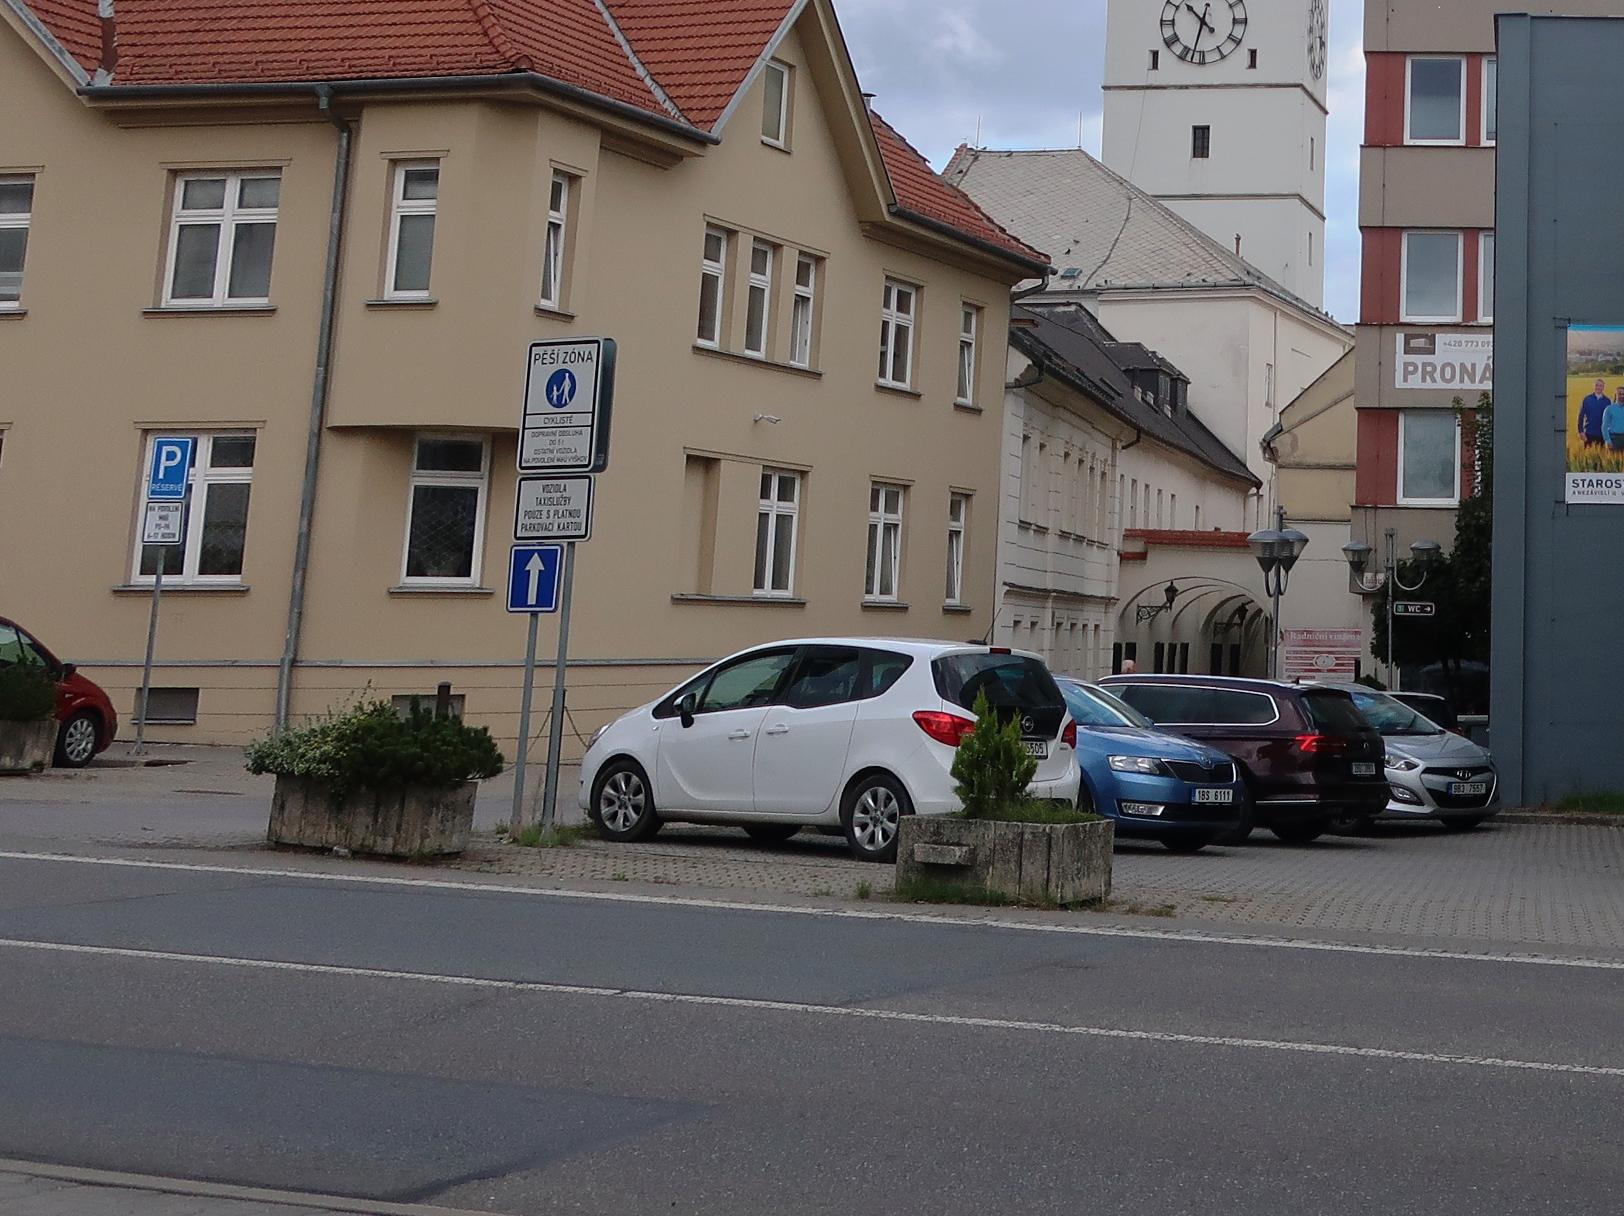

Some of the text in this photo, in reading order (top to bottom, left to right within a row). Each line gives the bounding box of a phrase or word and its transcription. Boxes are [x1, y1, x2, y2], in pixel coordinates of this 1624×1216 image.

[533, 349, 593, 365] PĚŠÍ ZÓNA
[158, 446, 182, 479] P
